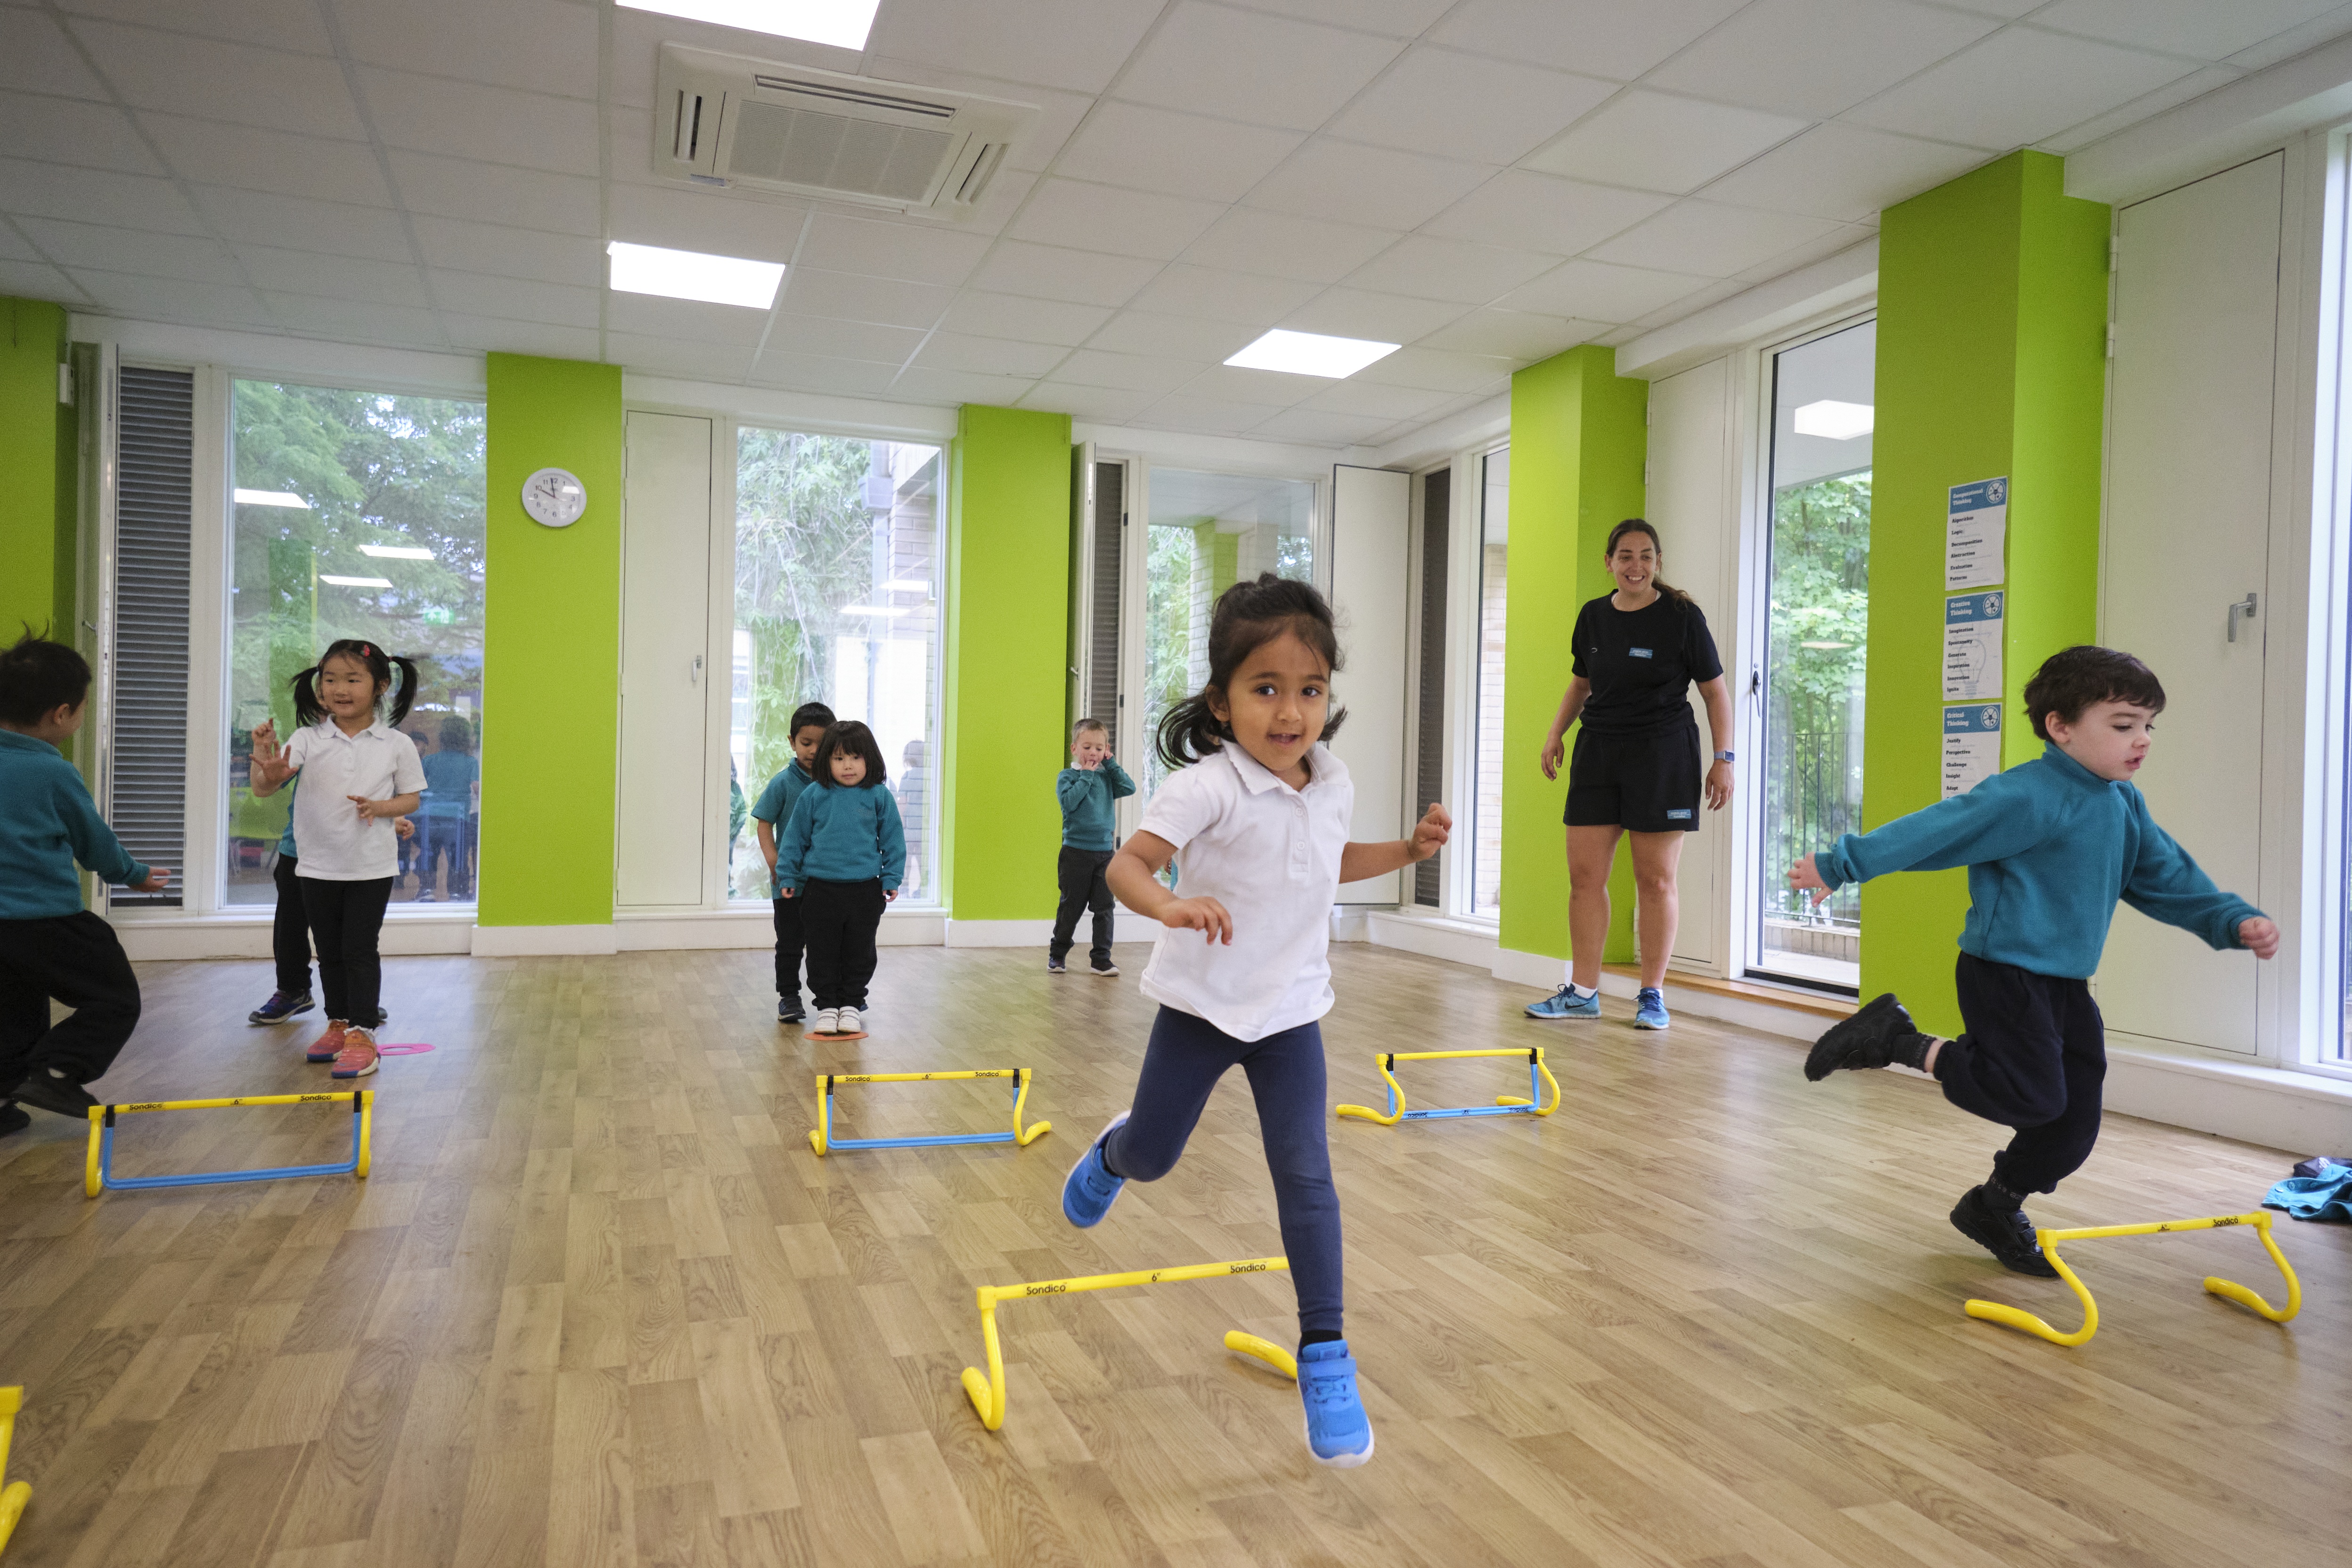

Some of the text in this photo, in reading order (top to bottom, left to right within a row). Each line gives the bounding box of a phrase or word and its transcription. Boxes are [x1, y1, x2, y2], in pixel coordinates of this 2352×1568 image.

[1952, 539, 1983, 547] Decomposition
[1027, 1284, 1066, 1295] Sondico
[1230, 1263, 1266, 1274] Sondico
